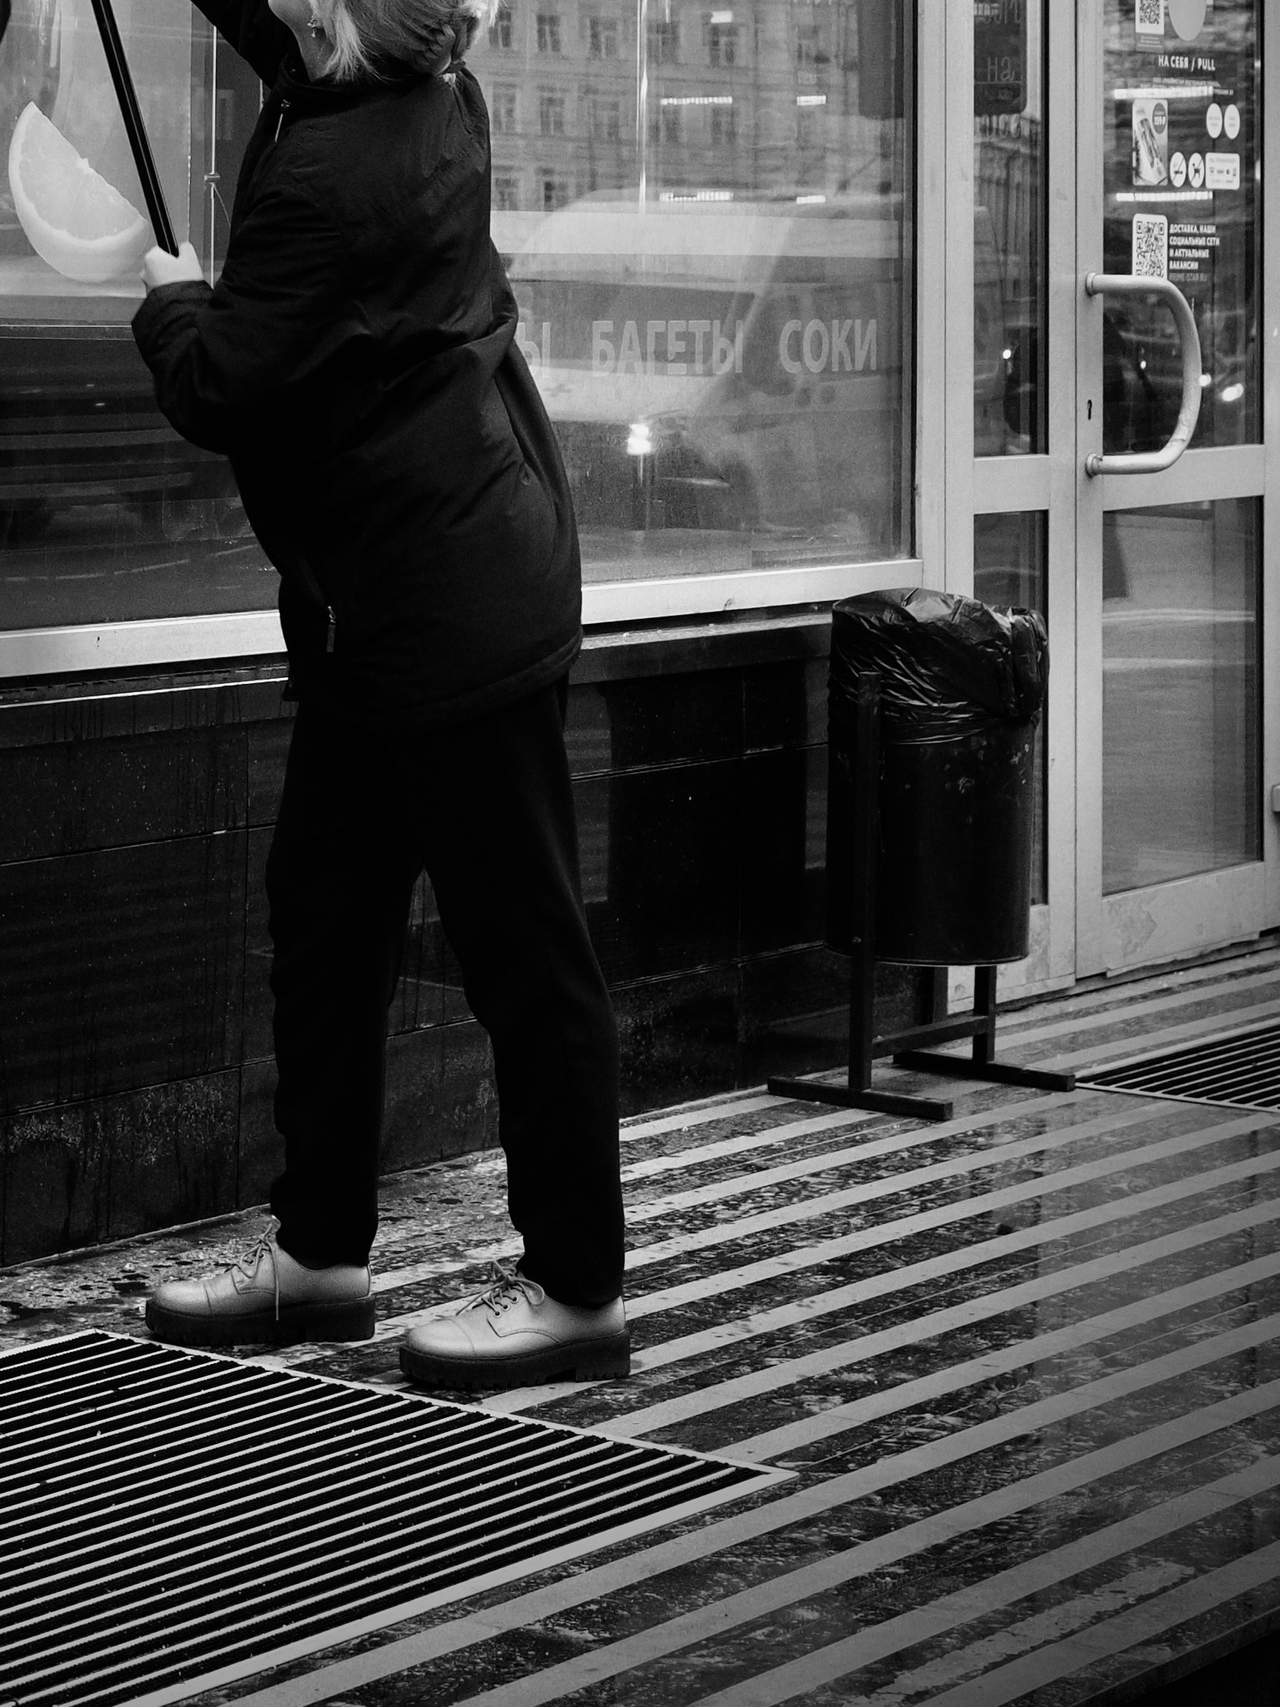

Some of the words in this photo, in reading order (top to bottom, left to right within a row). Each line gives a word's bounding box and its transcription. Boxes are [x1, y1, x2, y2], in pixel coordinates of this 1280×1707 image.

[1158, 55, 1169, 67] НА
[1197, 58, 1216, 71] PULL
[592, 320, 743, 377] БАГЕТЫ
[779, 319, 877, 374] СОКИ
